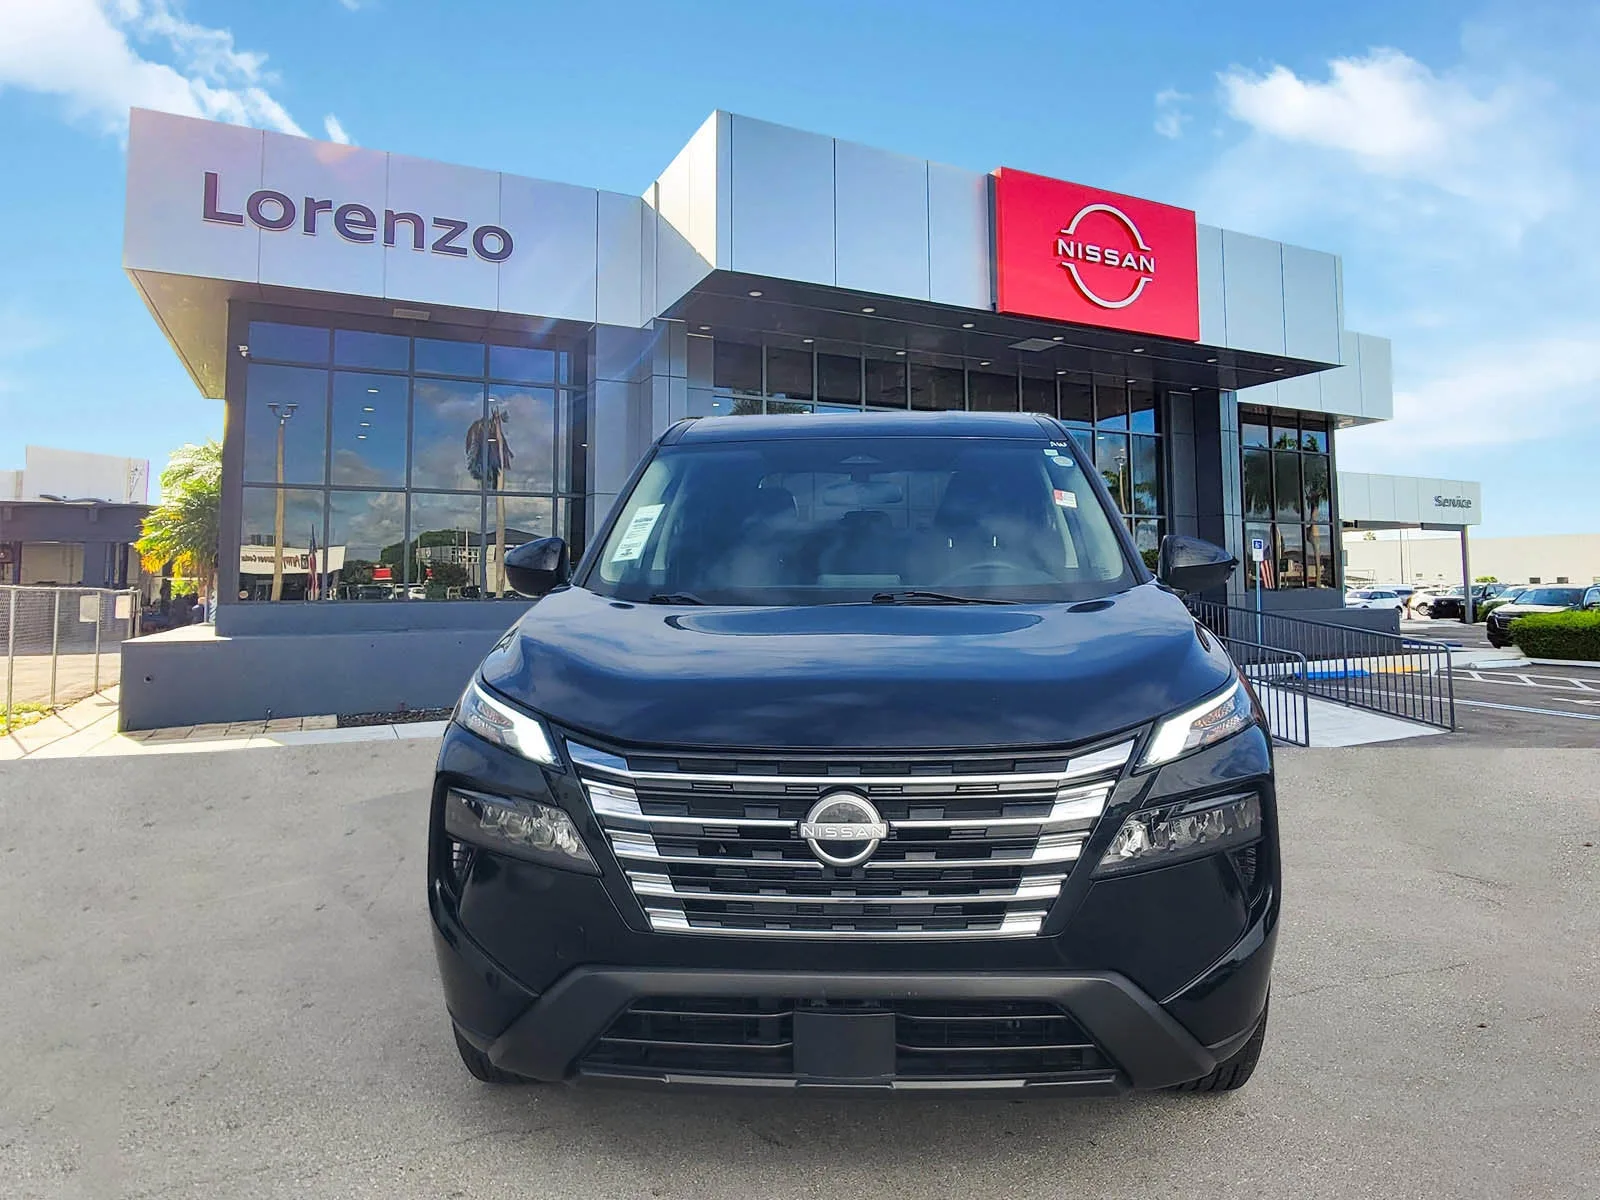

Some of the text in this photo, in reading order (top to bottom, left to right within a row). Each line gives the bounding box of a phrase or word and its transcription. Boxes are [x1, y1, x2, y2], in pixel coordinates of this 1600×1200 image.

[203, 171, 514, 263] Lorenzo
[1057, 238, 1155, 273] NISSAN
[1434, 495, 1472, 509] Service
[802, 825, 885, 838] NISSAN
